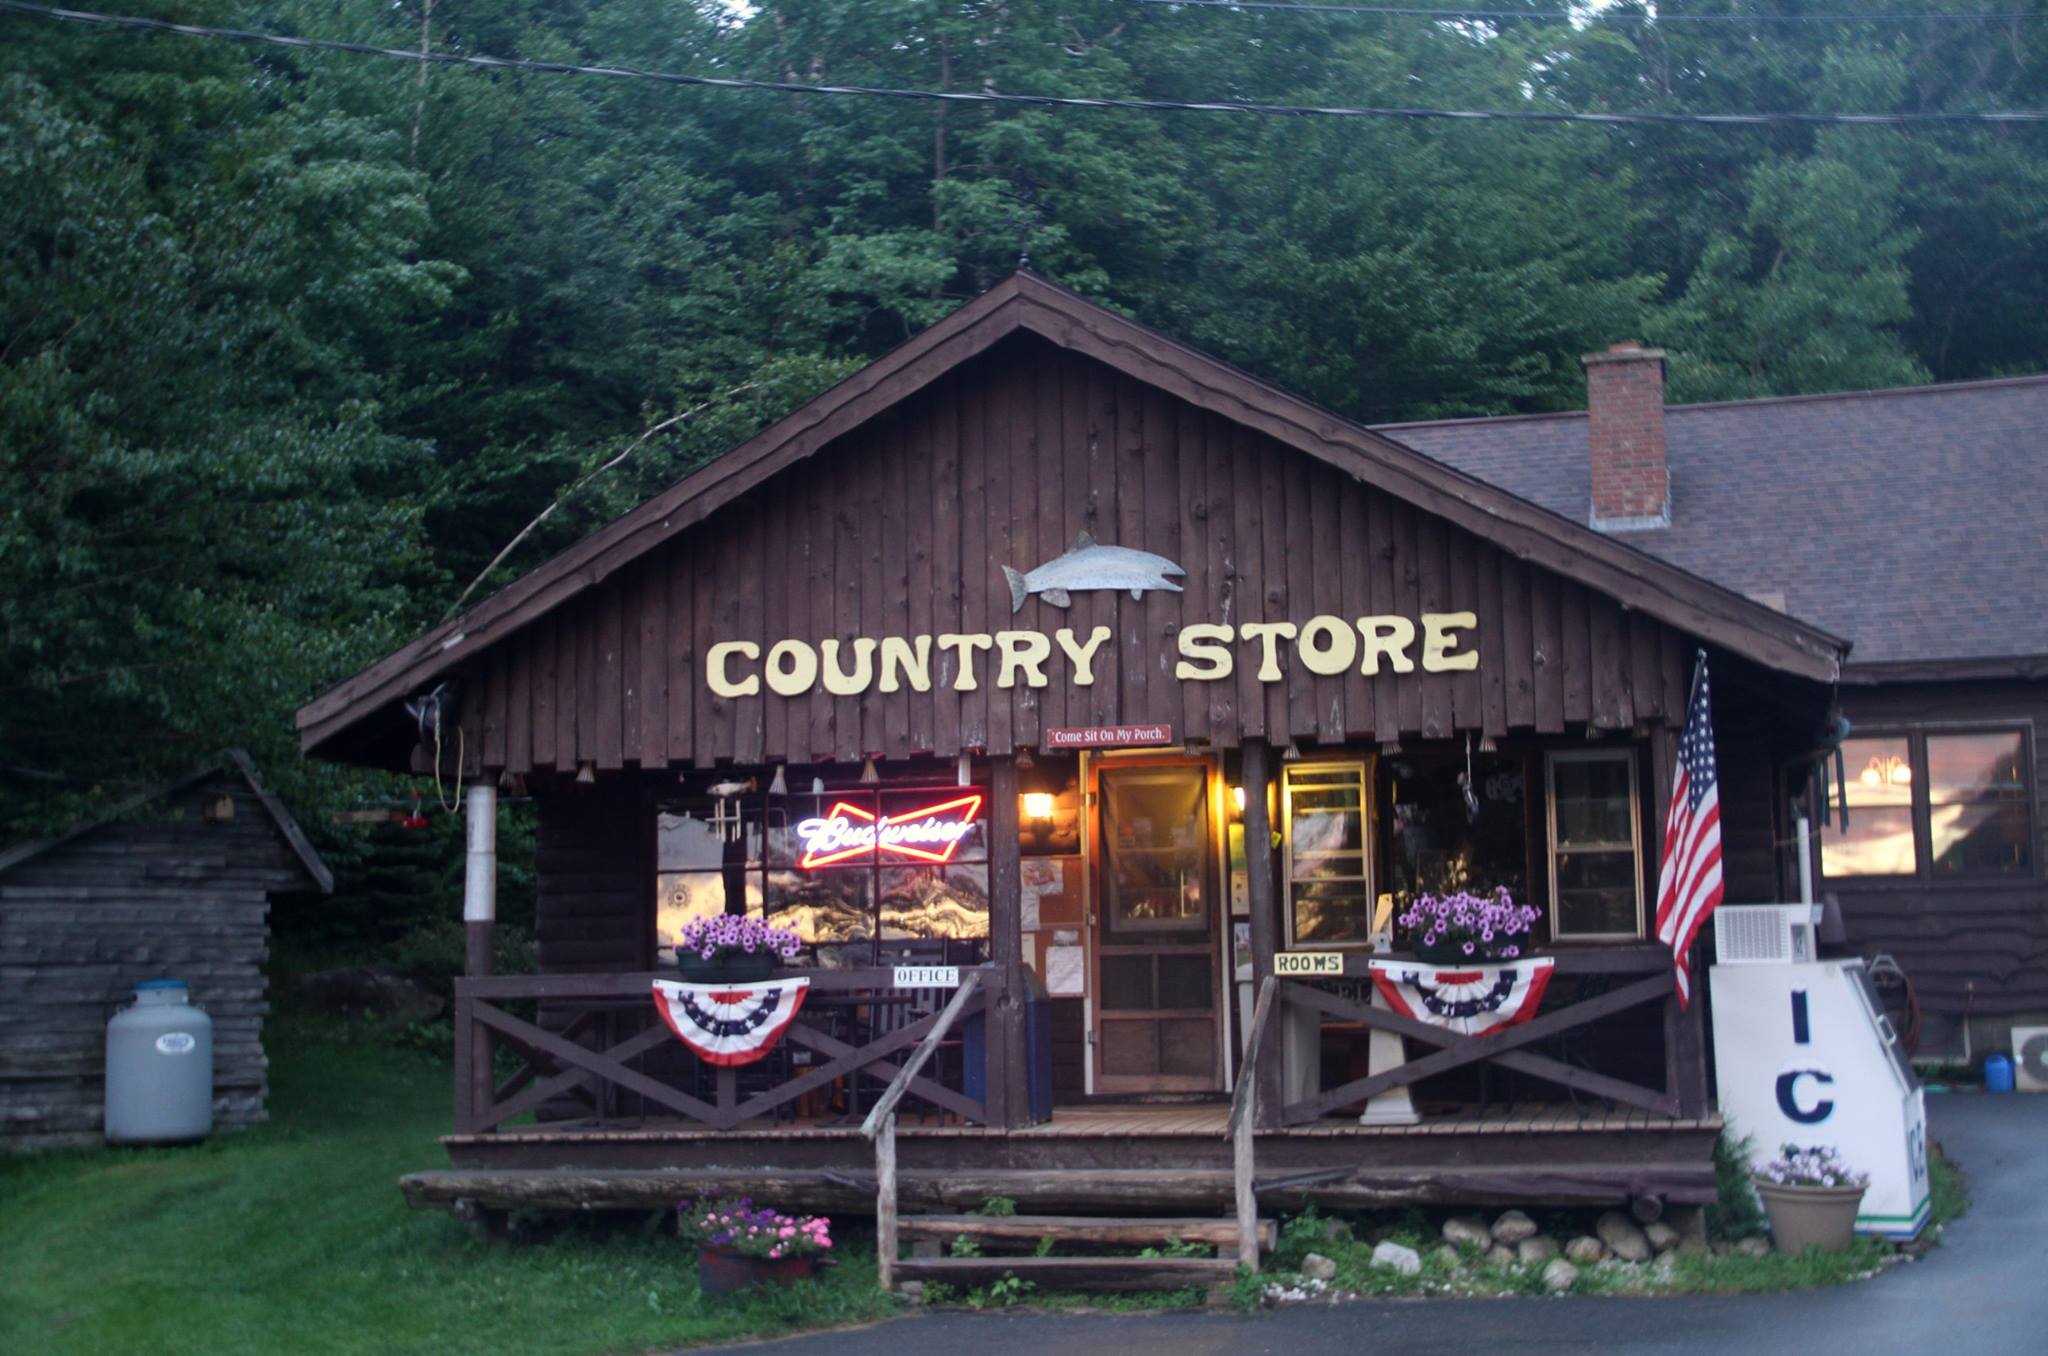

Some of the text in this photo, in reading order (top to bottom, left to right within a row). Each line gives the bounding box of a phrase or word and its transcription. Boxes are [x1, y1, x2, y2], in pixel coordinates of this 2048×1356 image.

[706, 611, 1479, 698] COUNTRY STORE
[1055, 731, 1082, 742] Come
[1084, 731, 1098, 741] Sit
[1100, 730, 1114, 740] On
[1117, 729, 1132, 743] My
[1278, 955, 1340, 971] ROOMS
[897, 969, 955, 982] OFFICE
